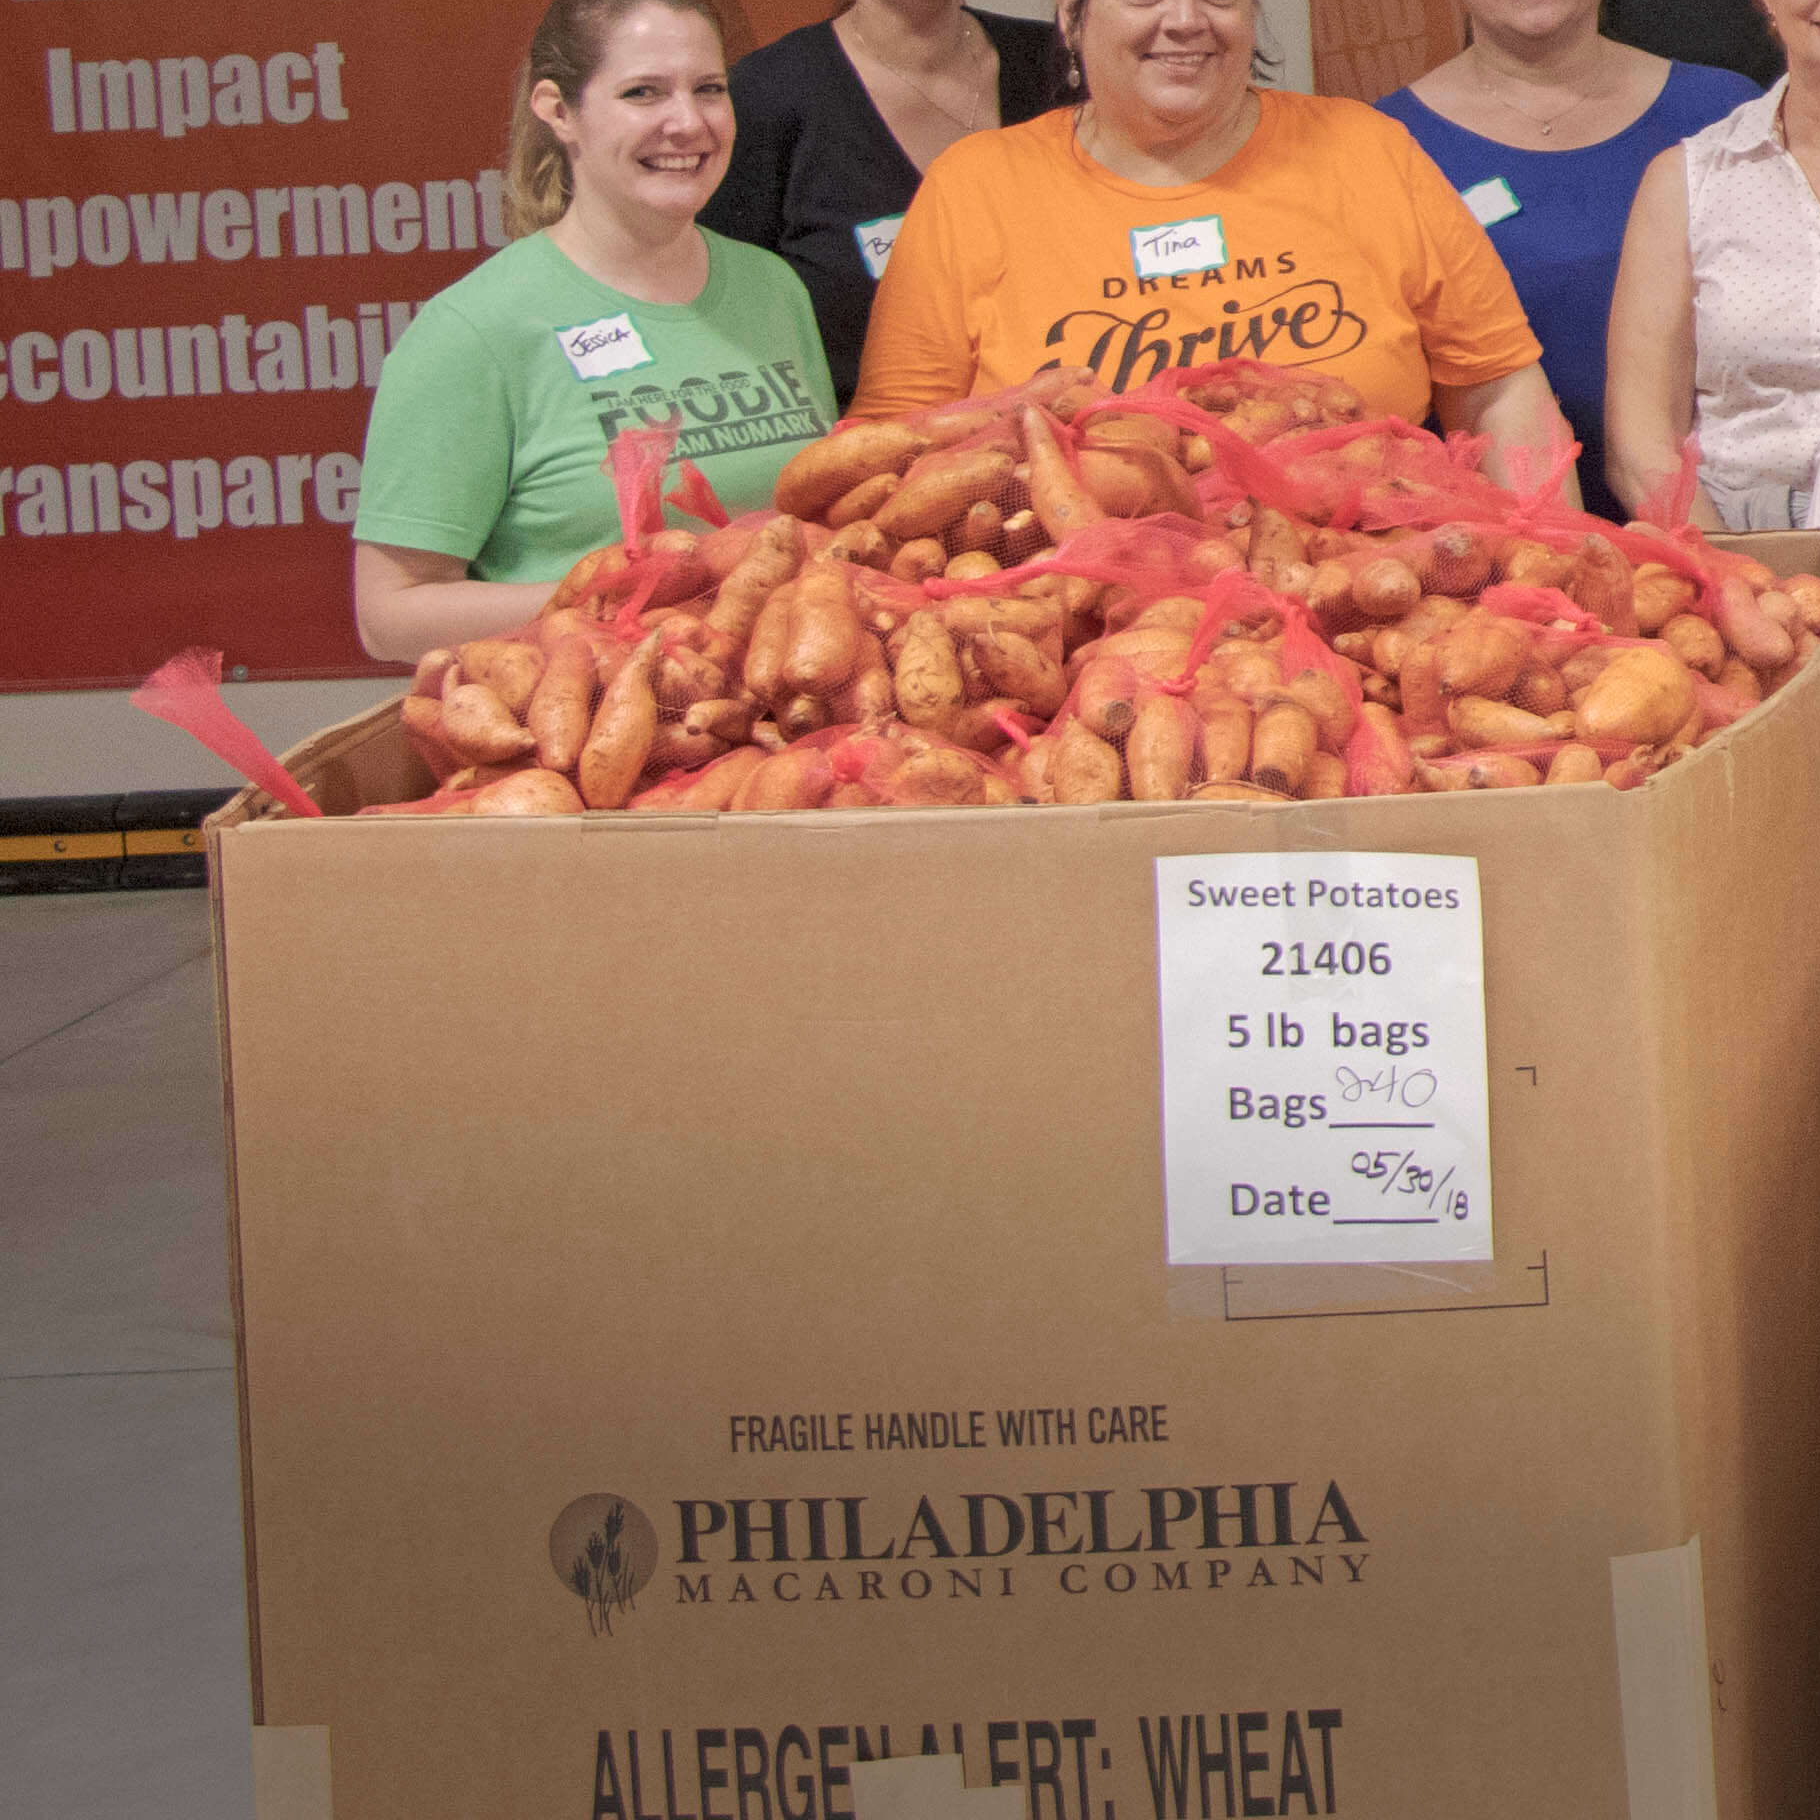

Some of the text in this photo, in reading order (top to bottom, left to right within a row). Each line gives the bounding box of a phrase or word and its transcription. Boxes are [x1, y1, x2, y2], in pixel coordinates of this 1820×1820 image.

[47, 42, 349, 139] Impact
[1143, 232, 1201, 259] Tina
[1102, 251, 1298, 300] DREAMS
[570, 327, 631, 357] JESSICA
[1042, 279, 1368, 394] Thrive
[591, 360, 812, 443] FOODIE
[639, 391, 669, 407] HERE
[714, 411, 818, 450] NUMARK
[1187, 879, 1461, 910] Sweet Potatoes
[1261, 941, 1392, 977] 21406
[1228, 1012, 1431, 1057] 5 lb bags
[1229, 1066, 1438, 1128] Bags 240
[1231, 1183, 1332, 1217] Date
[729, 1404, 1170, 1454] FRAGILE HANDLE WITH CARE
[672, 1479, 1370, 1566] PHILADELPHIA
[675, 1552, 1372, 1604] MACARONI COMPANY
[1137, 1708, 1343, 1820] WHEAT
